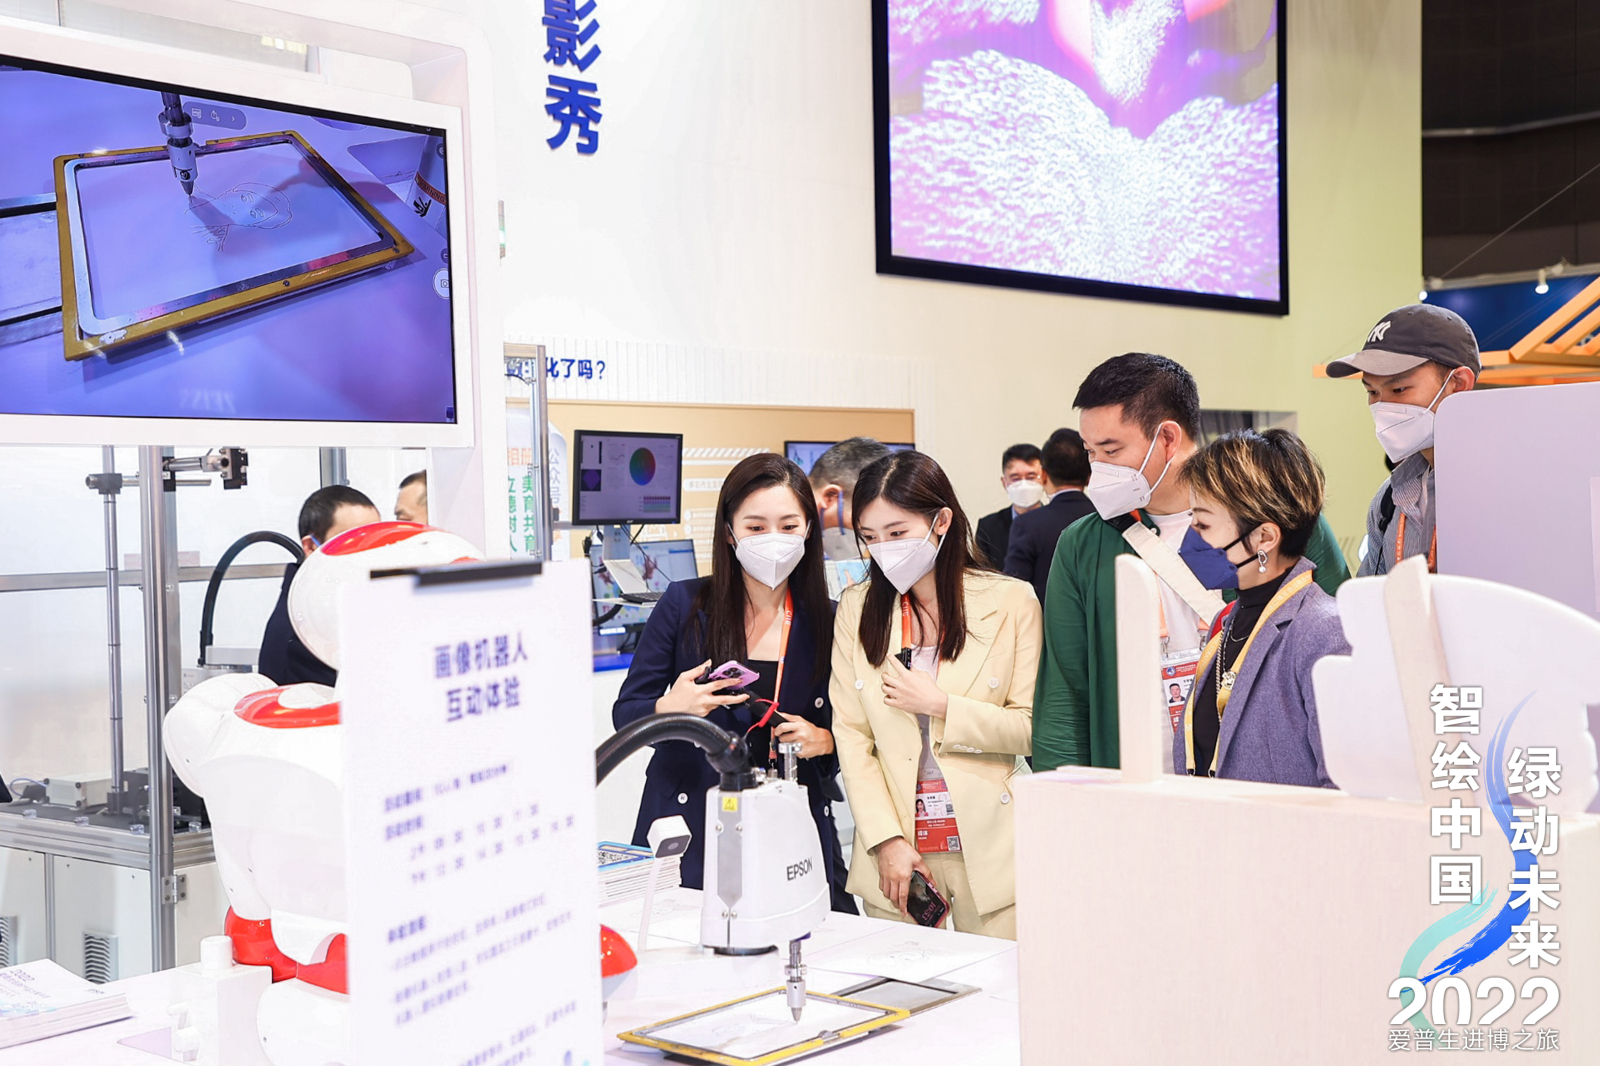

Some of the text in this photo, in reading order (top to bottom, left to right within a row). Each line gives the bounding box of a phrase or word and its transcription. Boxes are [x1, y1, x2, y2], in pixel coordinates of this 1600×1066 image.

[542, 0, 603, 155] 影秀
[1367, 320, 1392, 343] NY
[434, 631, 528, 679] 画像机器人
[446, 676, 521, 723] 互动体验
[786, 857, 813, 882] EPSON
